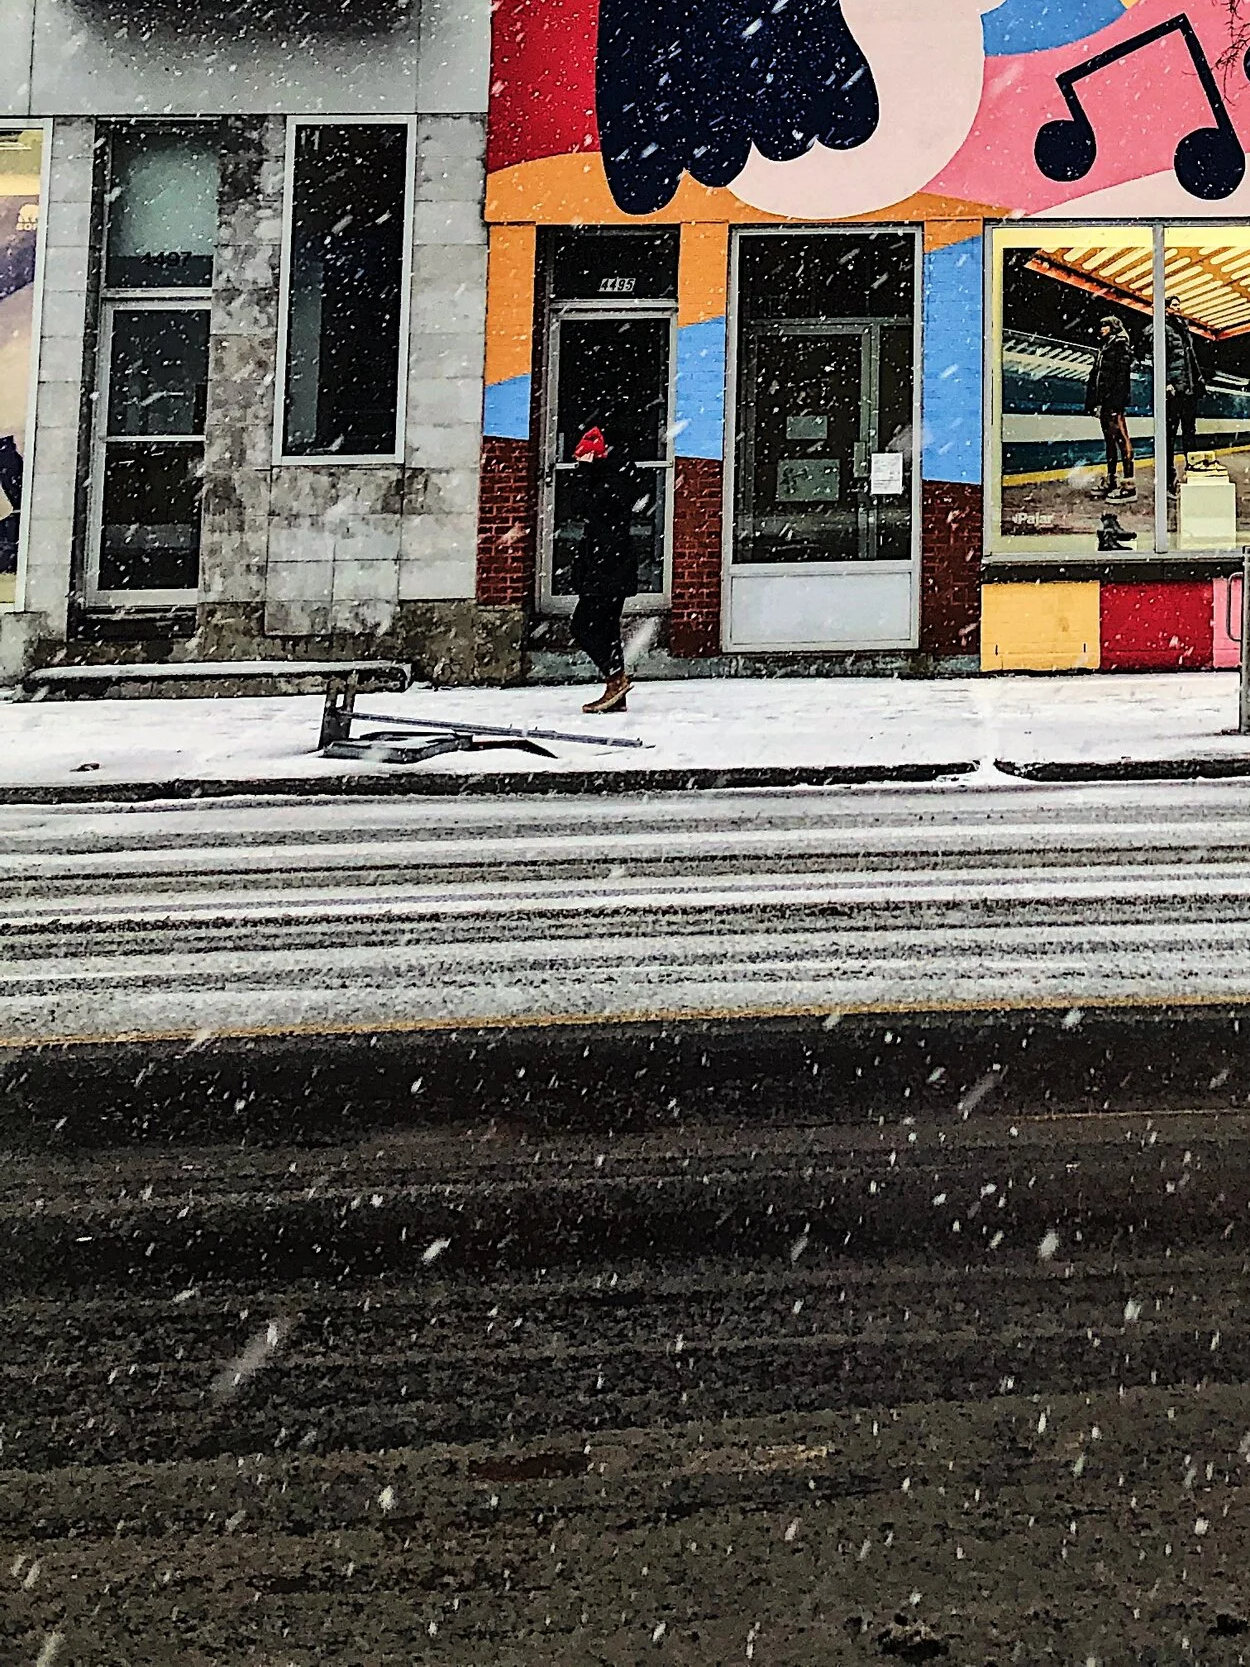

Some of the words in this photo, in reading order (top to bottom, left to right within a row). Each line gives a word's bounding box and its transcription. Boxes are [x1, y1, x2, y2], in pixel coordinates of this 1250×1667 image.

[141, 251, 192, 266] 4497
[600, 278, 635, 291] 4495
[1016, 512, 1053, 527] Pajar
